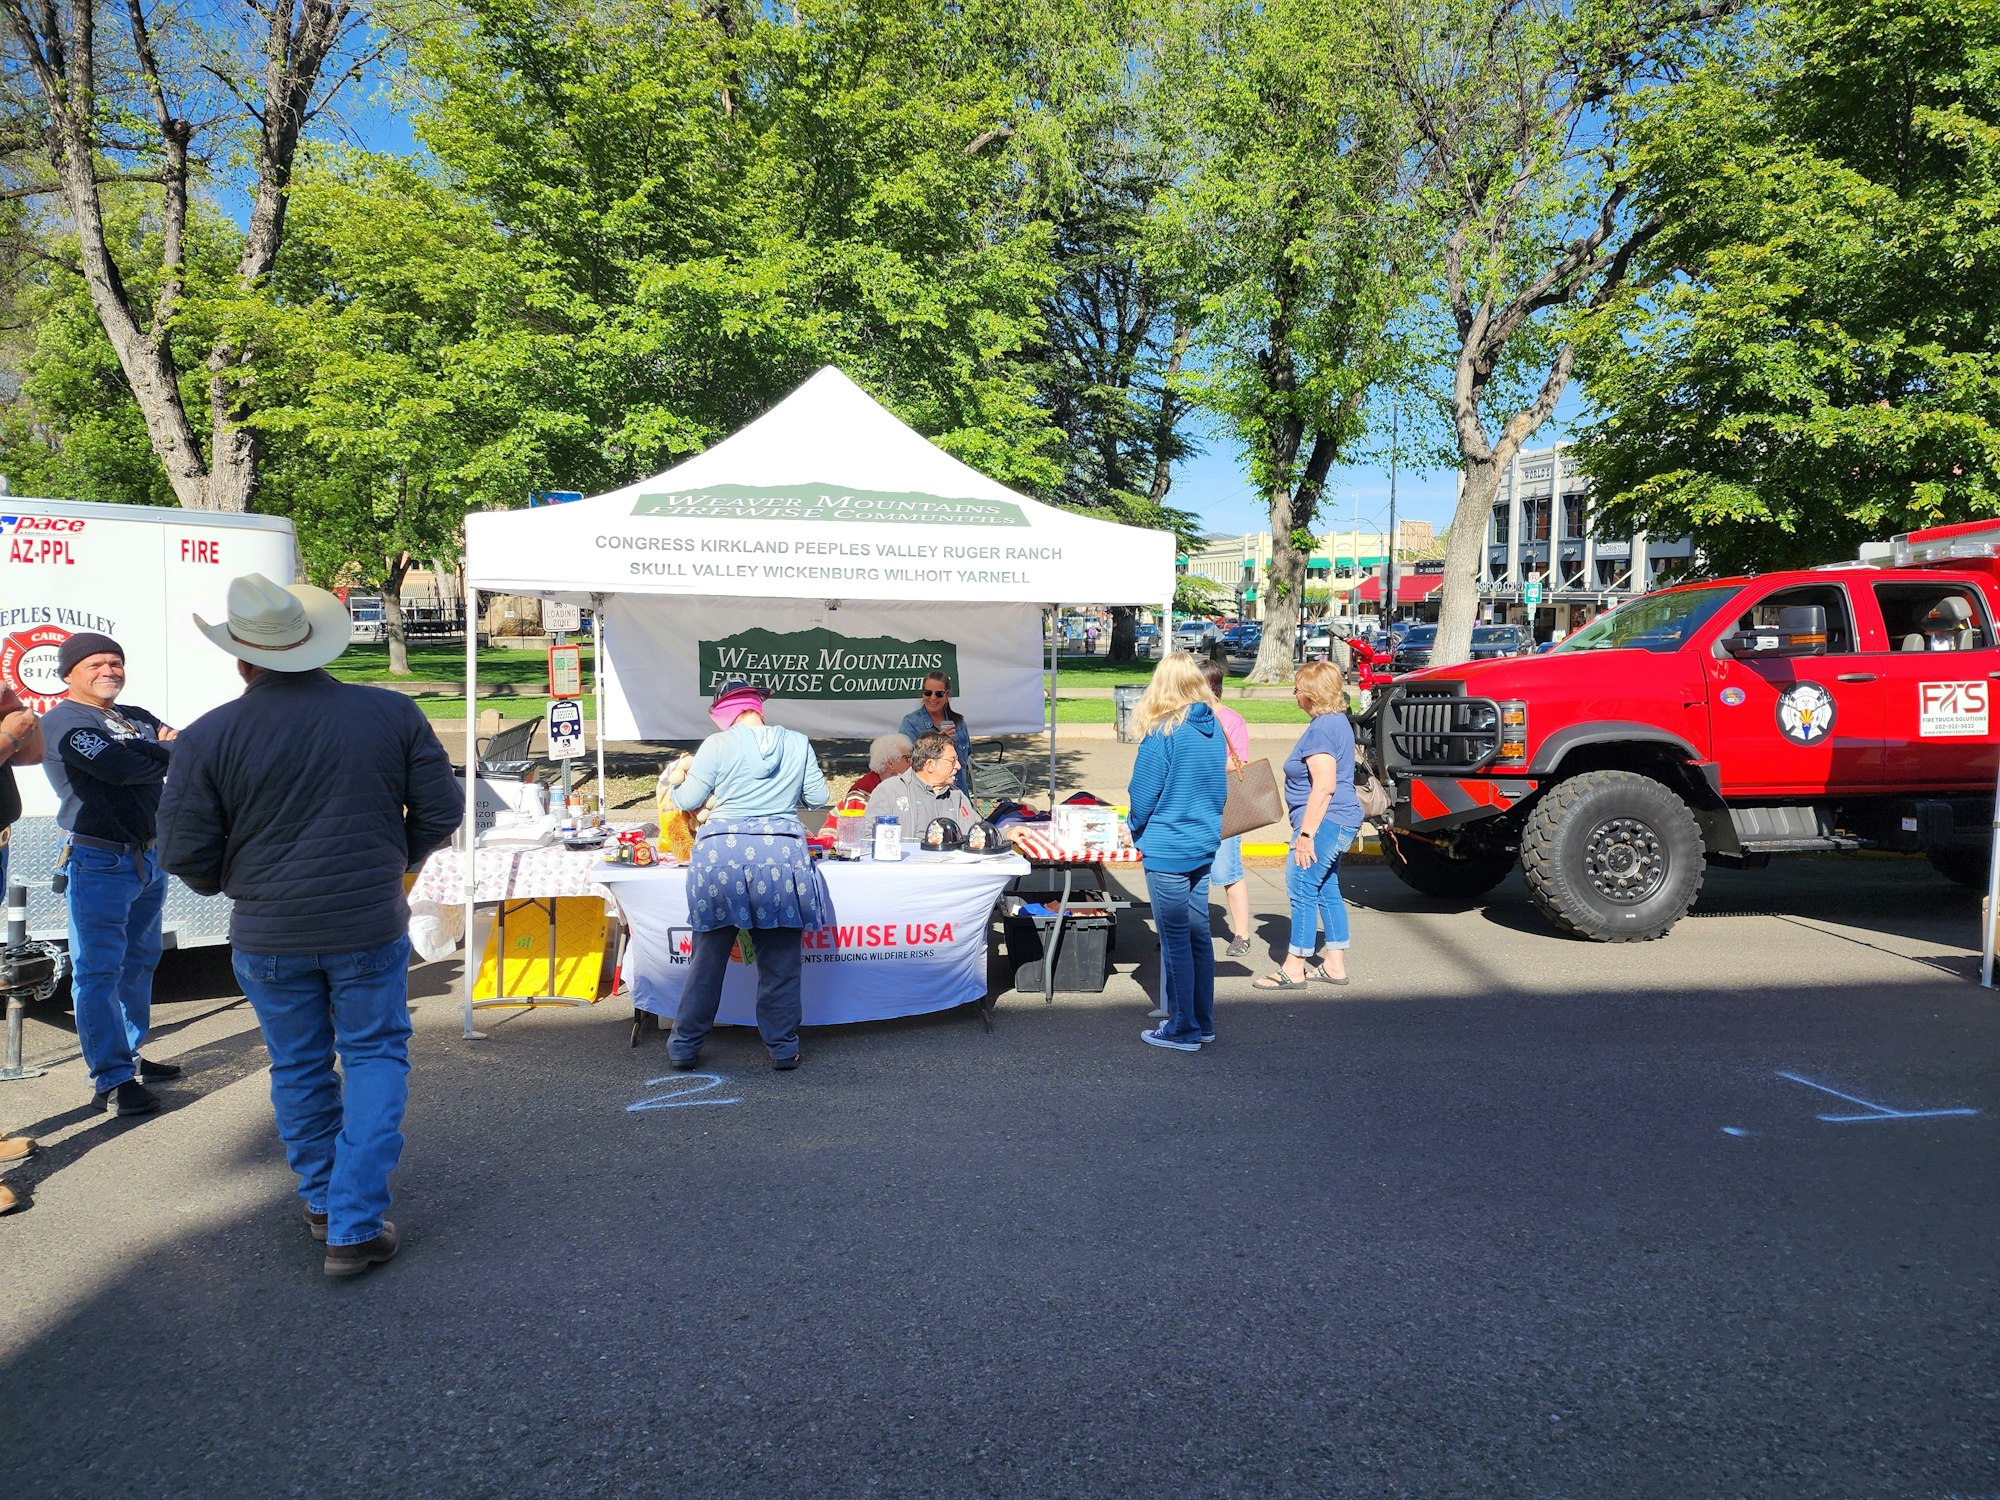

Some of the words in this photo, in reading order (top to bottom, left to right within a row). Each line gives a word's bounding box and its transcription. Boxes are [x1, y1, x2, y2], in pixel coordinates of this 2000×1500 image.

[666, 494, 803, 507] WEAVER
[813, 495, 1000, 514] MOUNTAINS
[645, 506, 823, 518] FIREWISE
[833, 509, 1016, 524] COMMUNITIES
[13, 516, 86, 534] pace
[9, 538, 76, 565] AZ-PPL
[180, 539, 220, 564] FIRE
[595, 535, 695, 552] CONGRESS
[701, 539, 789, 554] KIRKLAND
[795, 542, 871, 557] PEEPLES
[876, 543, 938, 558] VALLEY
[944, 546, 1001, 560] RUGER
[1006, 547, 1062, 560] RANCH
[630, 562, 687, 576] SKULL
[692, 564, 758, 578] VALLEY
[763, 565, 879, 580] WICKENBURG
[885, 569, 952, 582] WILHOIT
[957, 570, 1031, 584] YARNELL
[1476, 581, 1502, 593] ASHFORD
[0, 606, 51, 627] EPLES
[56, 607, 116, 635] VALLEY
[546, 610, 576, 618] LOADING
[23, 655, 60, 665] STATIO
[717, 646, 810, 671] WEAVER
[816, 648, 942, 671] MOUNTAINS
[2, 647, 18, 691] SUPPORT
[23, 668, 60, 679] 81/8
[829, 674, 952, 692] COMMUNIT
[475, 800, 489, 809] ep
[475, 821, 493, 829] ean
[801, 925, 897, 949] REWISE
[670, 955, 691, 965] NF
[824, 952, 867, 963] REDUCING
[869, 950, 908, 962] WILDFIRE
[910, 949, 935, 959] RISKS
[625, 1073, 742, 1112] 2
